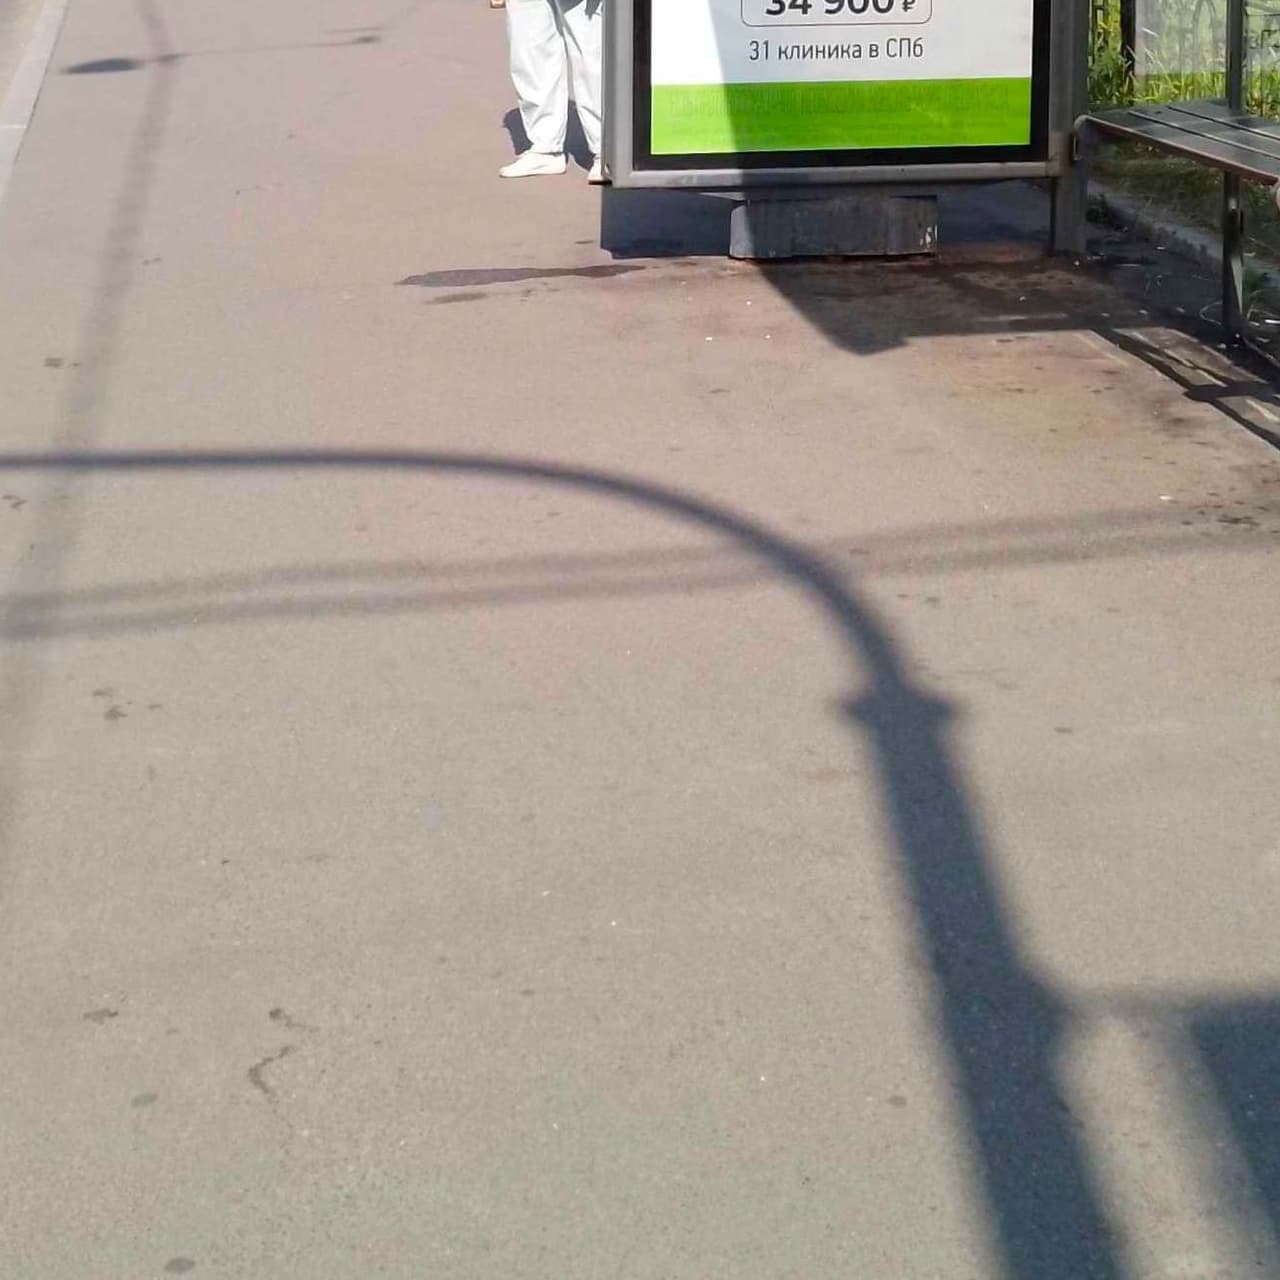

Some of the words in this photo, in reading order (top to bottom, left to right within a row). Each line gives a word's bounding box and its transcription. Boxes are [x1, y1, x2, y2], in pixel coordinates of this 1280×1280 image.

[749, 39, 770, 61] 31
[777, 41, 863, 60] клиника
[869, 42, 880, 59] в
[886, 36, 925, 58] СПб
